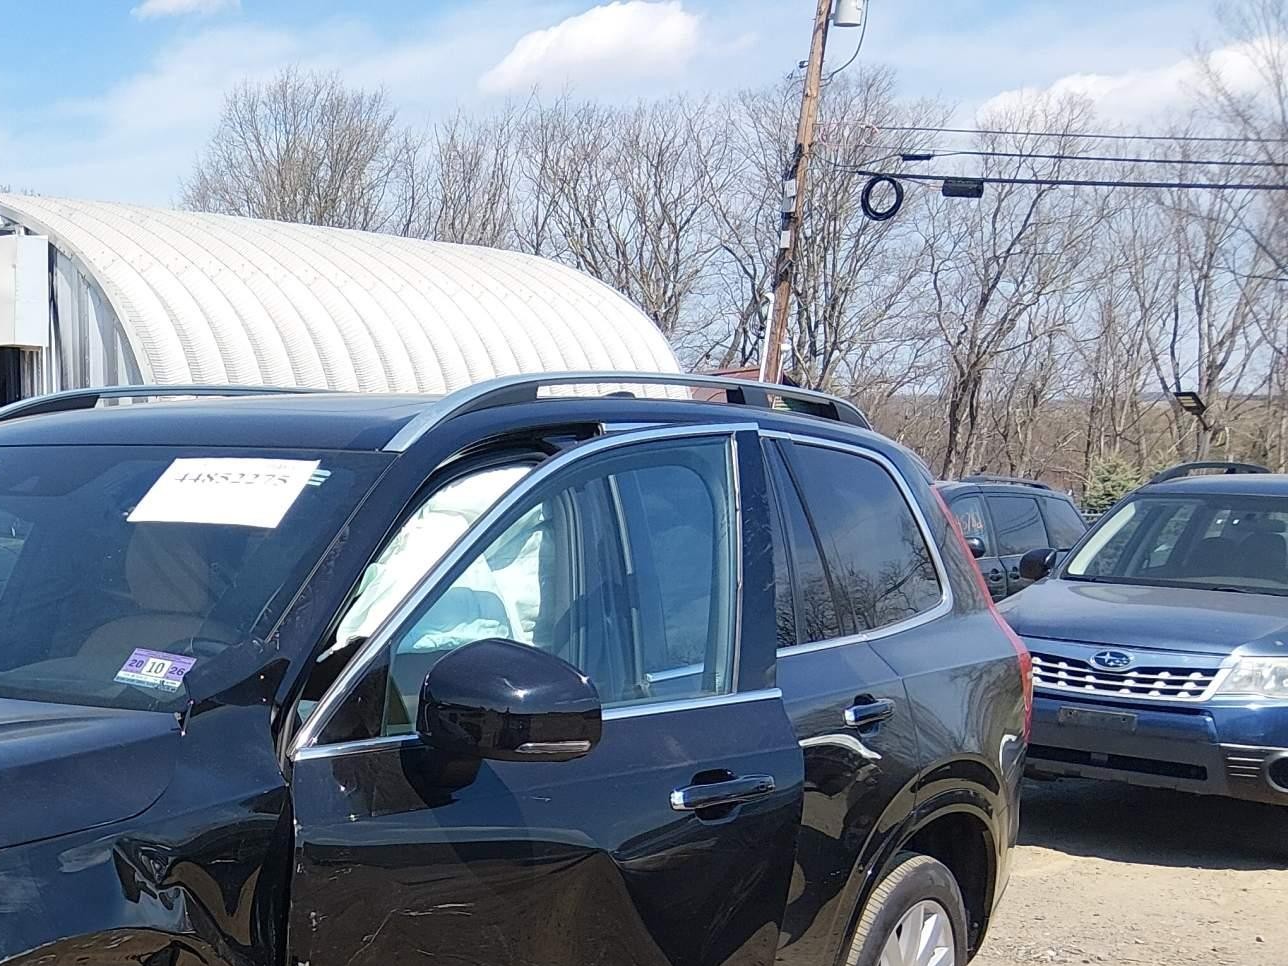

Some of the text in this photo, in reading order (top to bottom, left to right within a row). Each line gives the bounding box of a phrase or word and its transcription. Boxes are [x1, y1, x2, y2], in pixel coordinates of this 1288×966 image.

[128, 658, 186, 677] 20 10 26
